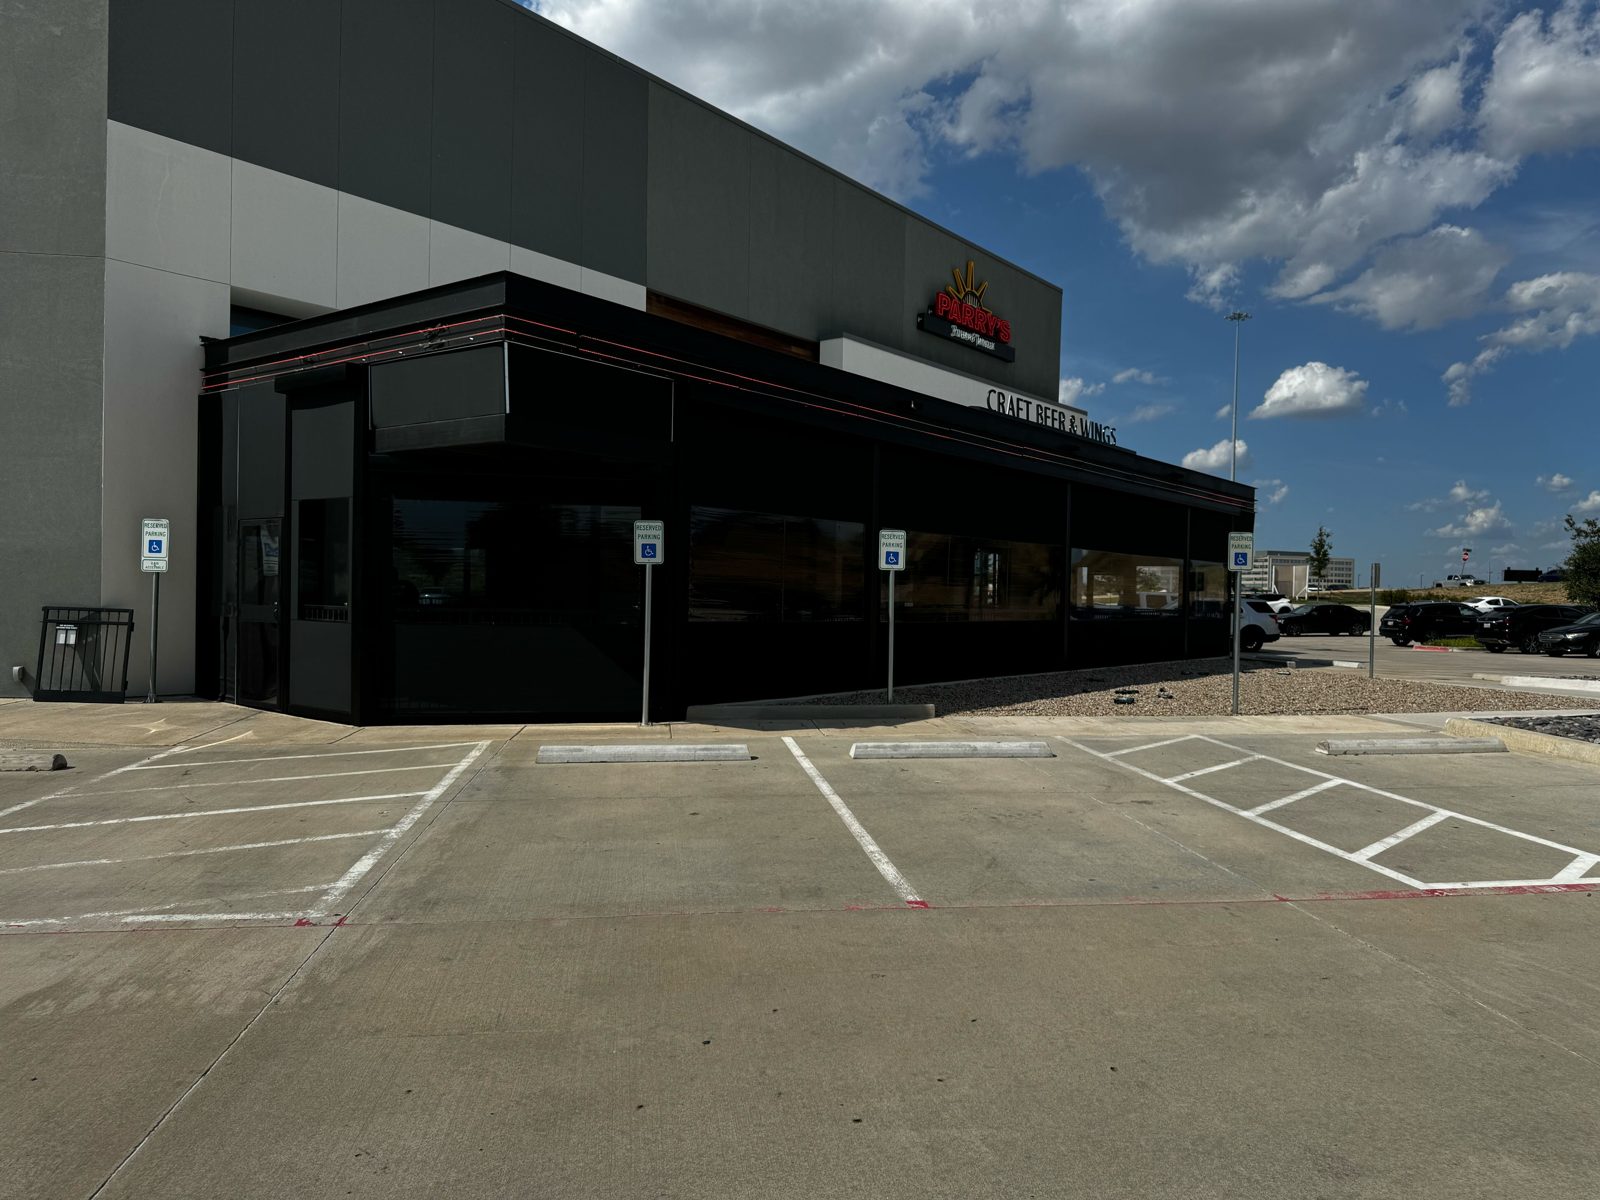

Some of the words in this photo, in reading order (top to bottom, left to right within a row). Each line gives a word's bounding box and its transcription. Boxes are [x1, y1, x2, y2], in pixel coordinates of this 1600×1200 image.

[936, 291, 1011, 344] PARRY'S
[987, 389, 1032, 420] CRAFT
[1036, 404, 1066, 431] BEER
[1068, 415, 1078, 434] &
[1080, 418, 1117, 446] WINGS
